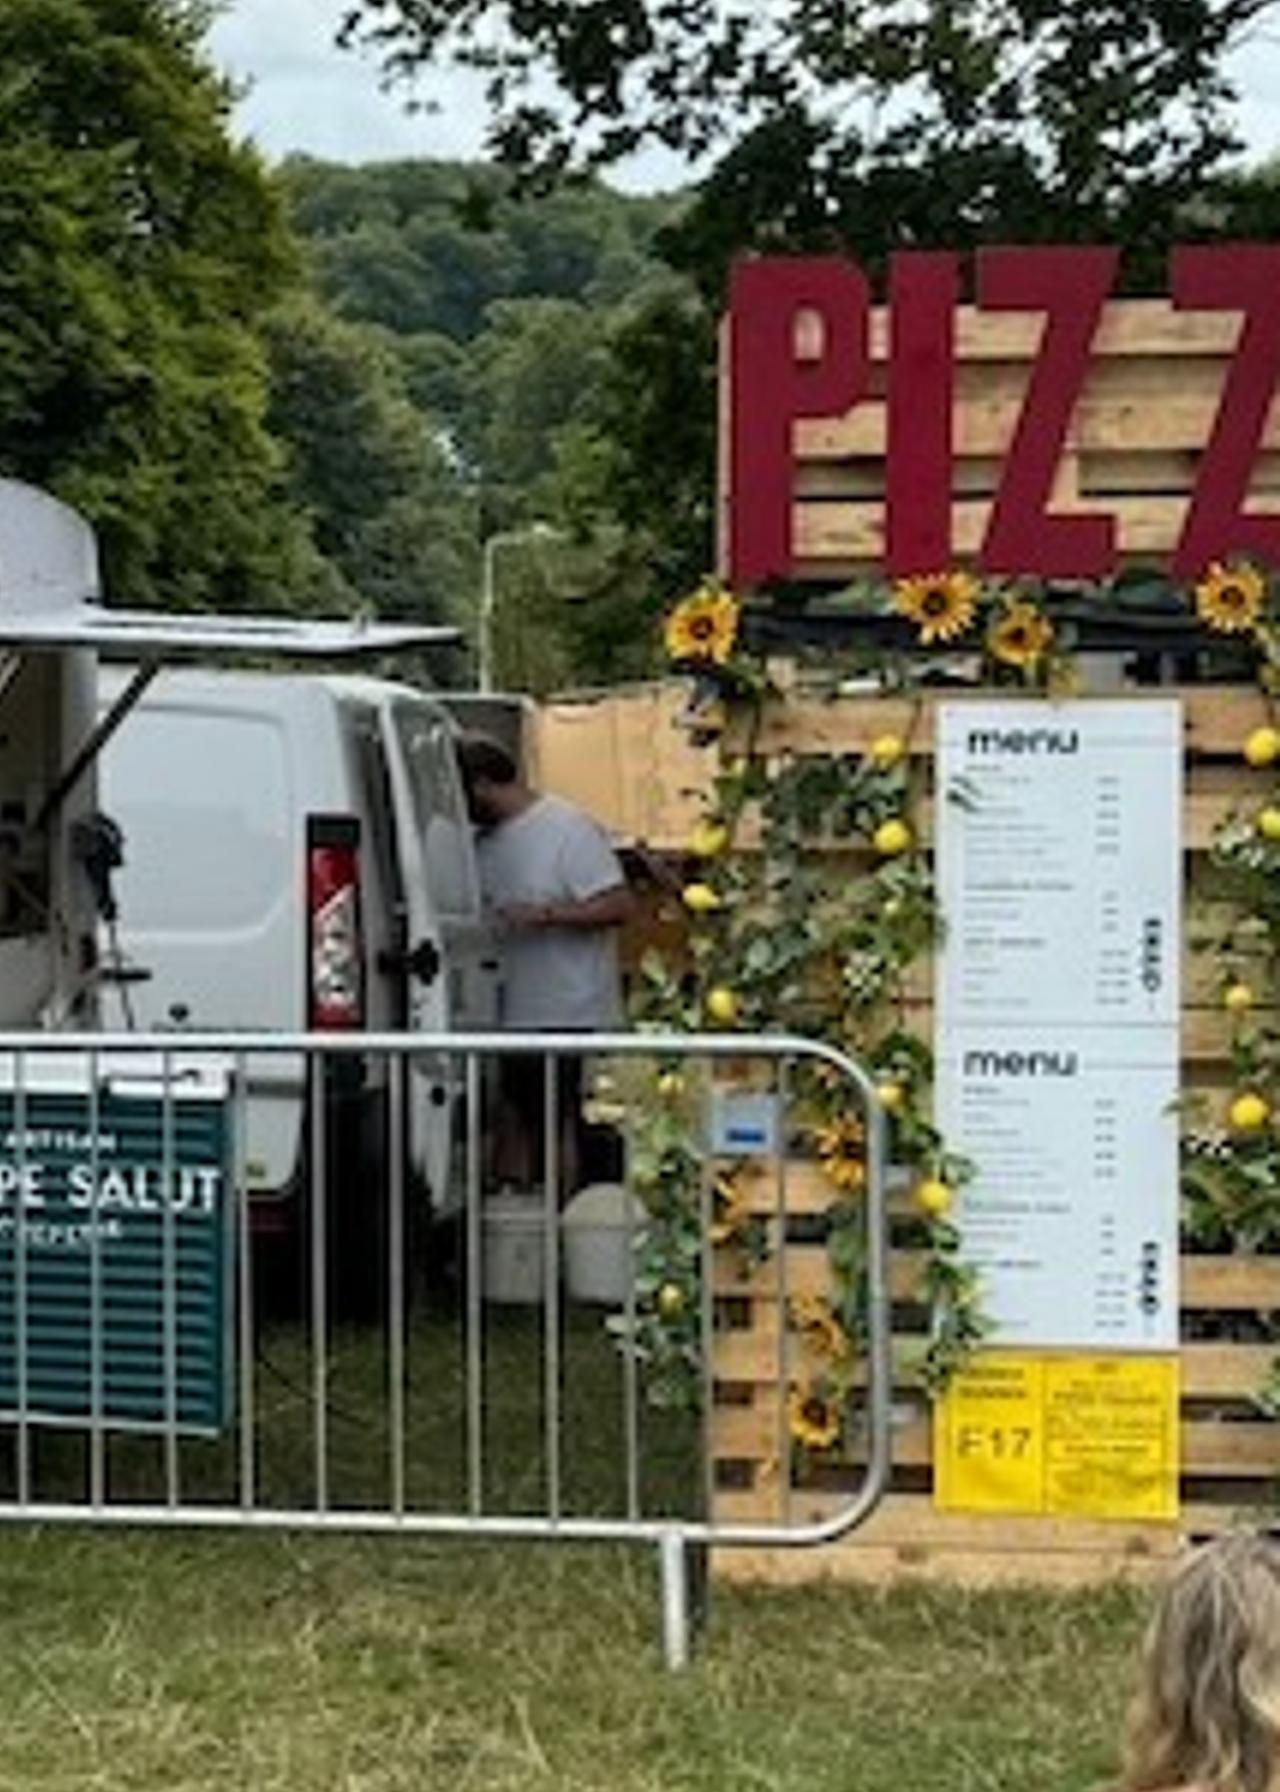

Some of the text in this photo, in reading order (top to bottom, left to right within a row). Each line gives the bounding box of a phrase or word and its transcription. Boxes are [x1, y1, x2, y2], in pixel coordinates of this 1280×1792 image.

[966, 729, 1080, 756] menu
[962, 1050, 1078, 1077] menu
[67, 1162, 221, 1213] SALUT
[956, 1425, 1032, 1459] F17
